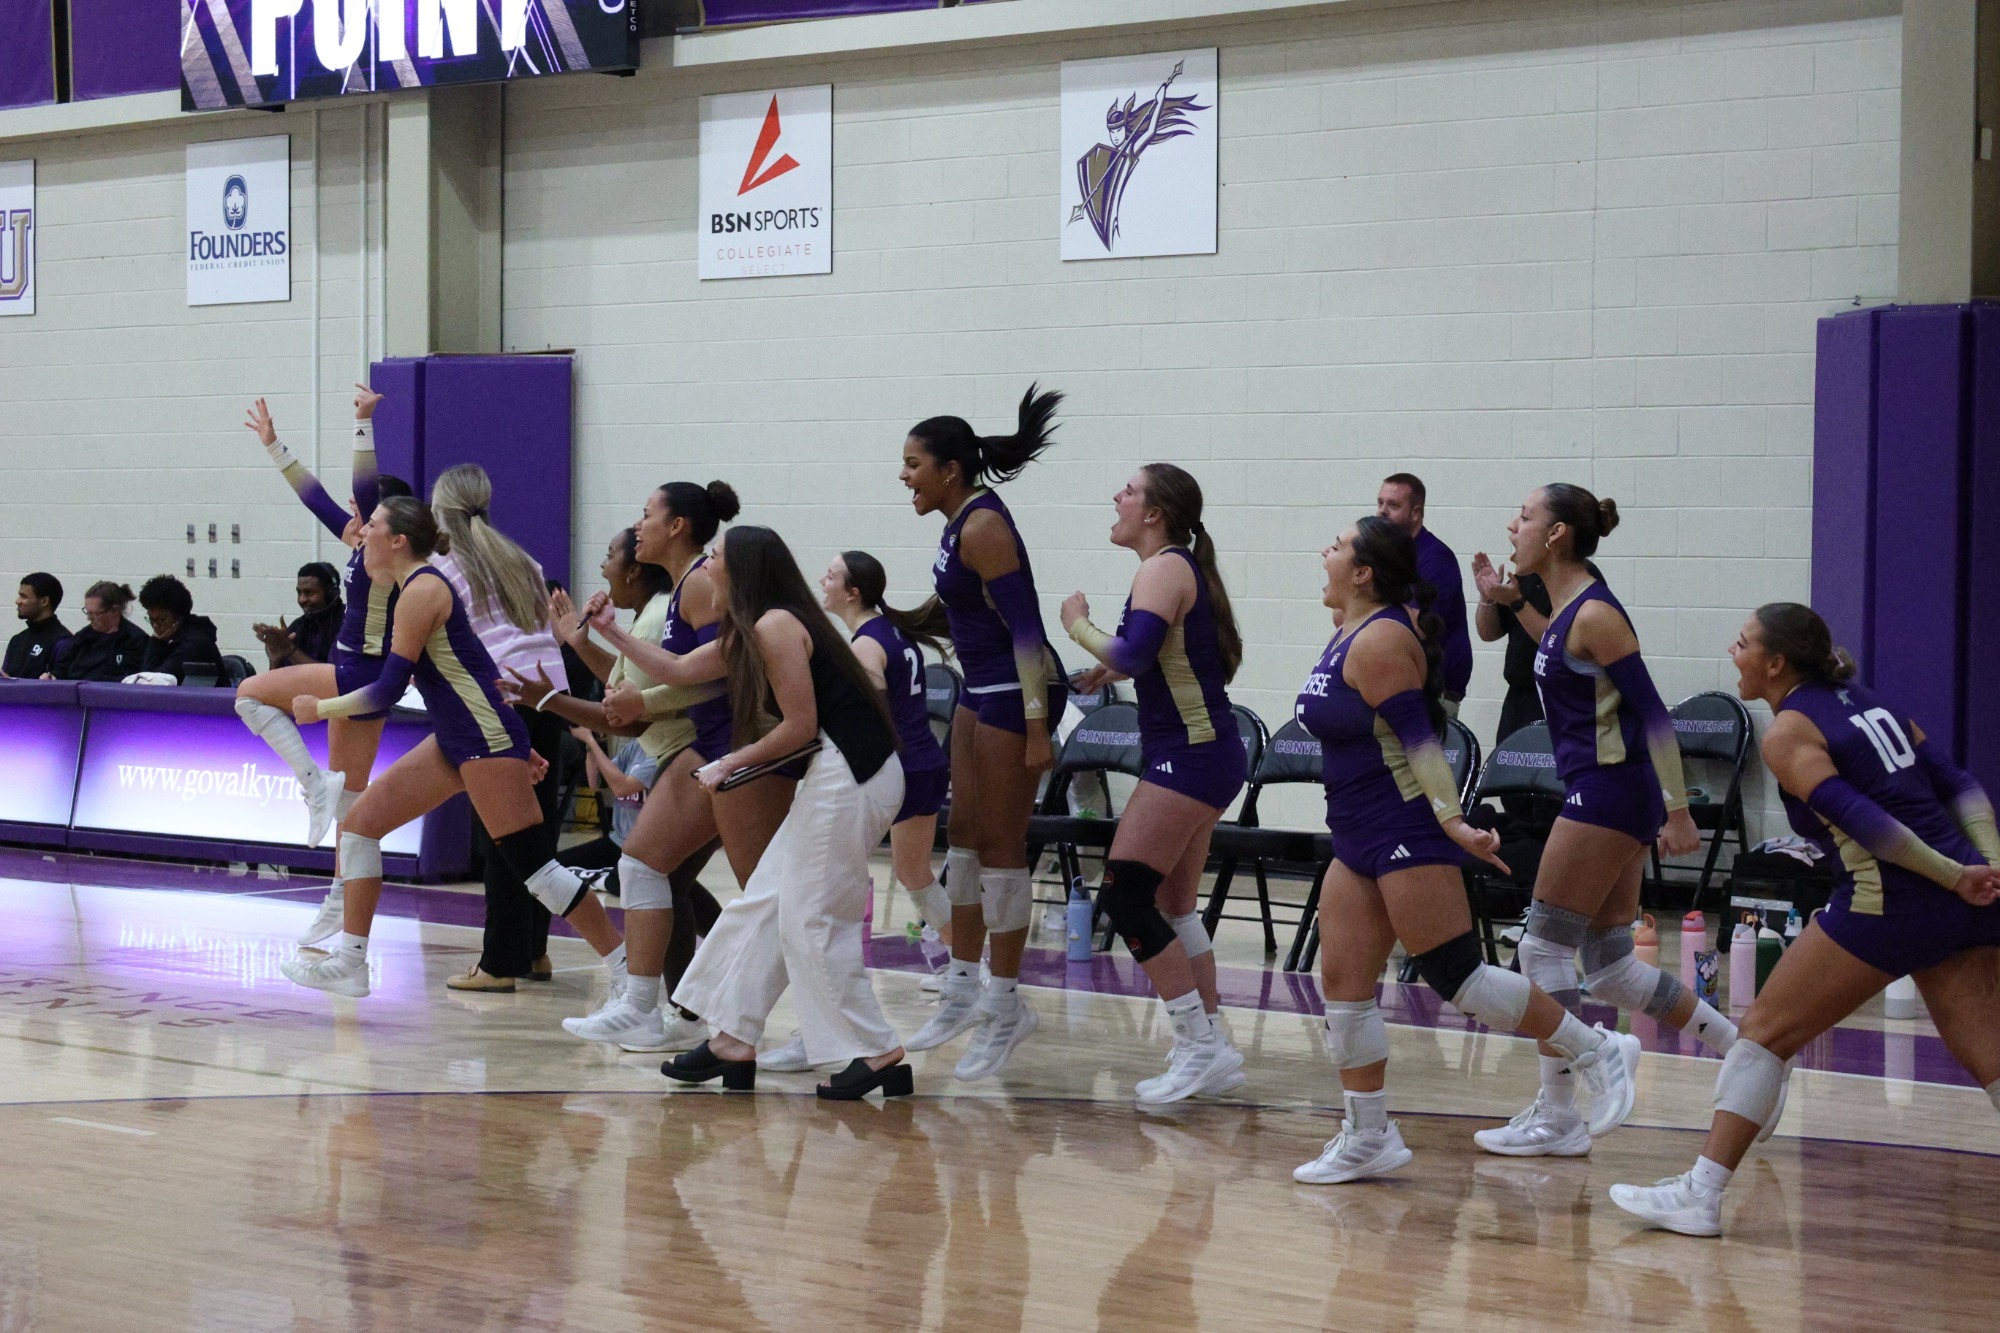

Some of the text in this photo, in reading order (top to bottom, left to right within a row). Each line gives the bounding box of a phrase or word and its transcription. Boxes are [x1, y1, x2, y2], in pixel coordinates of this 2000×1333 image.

[190, 231, 286, 260] FOUNDERS
[717, 243, 811, 260] COLLEGIATE
[191, 258, 285, 271] FEDERAL CREDIT UNION
[742, 263, 785, 276] SELECT
[903, 647, 922, 696] 2
[1077, 729, 1141, 745] CONVERSE
[1848, 706, 1916, 774] 10
[1275, 740, 1322, 755] CONVE
